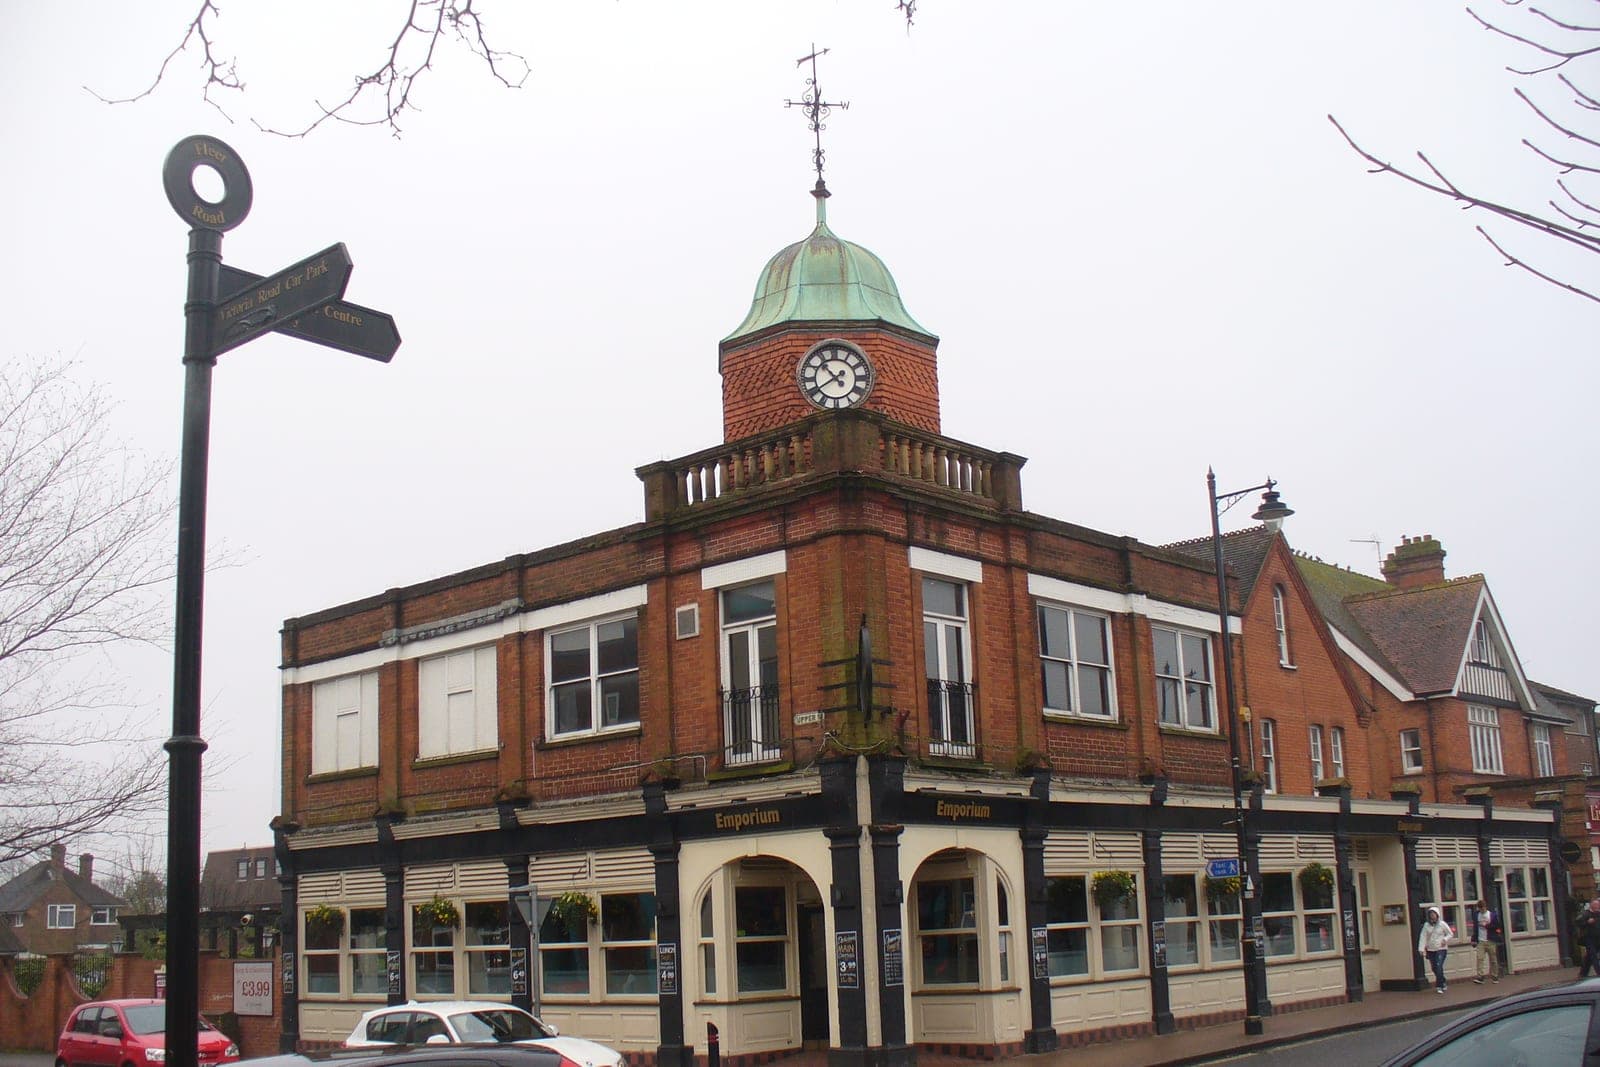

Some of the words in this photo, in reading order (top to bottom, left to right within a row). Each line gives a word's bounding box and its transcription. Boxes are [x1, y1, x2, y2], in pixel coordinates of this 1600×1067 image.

[192, 204, 225, 225] Road
[257, 281, 281, 304] Road
[285, 274, 303, 290] Car
[305, 260, 328, 281] Park
[324, 304, 363, 326] Centre
[715, 807, 780, 832] Emporium
[937, 800, 990, 822] Emporium
[243, 981, 269, 997] £3.99
